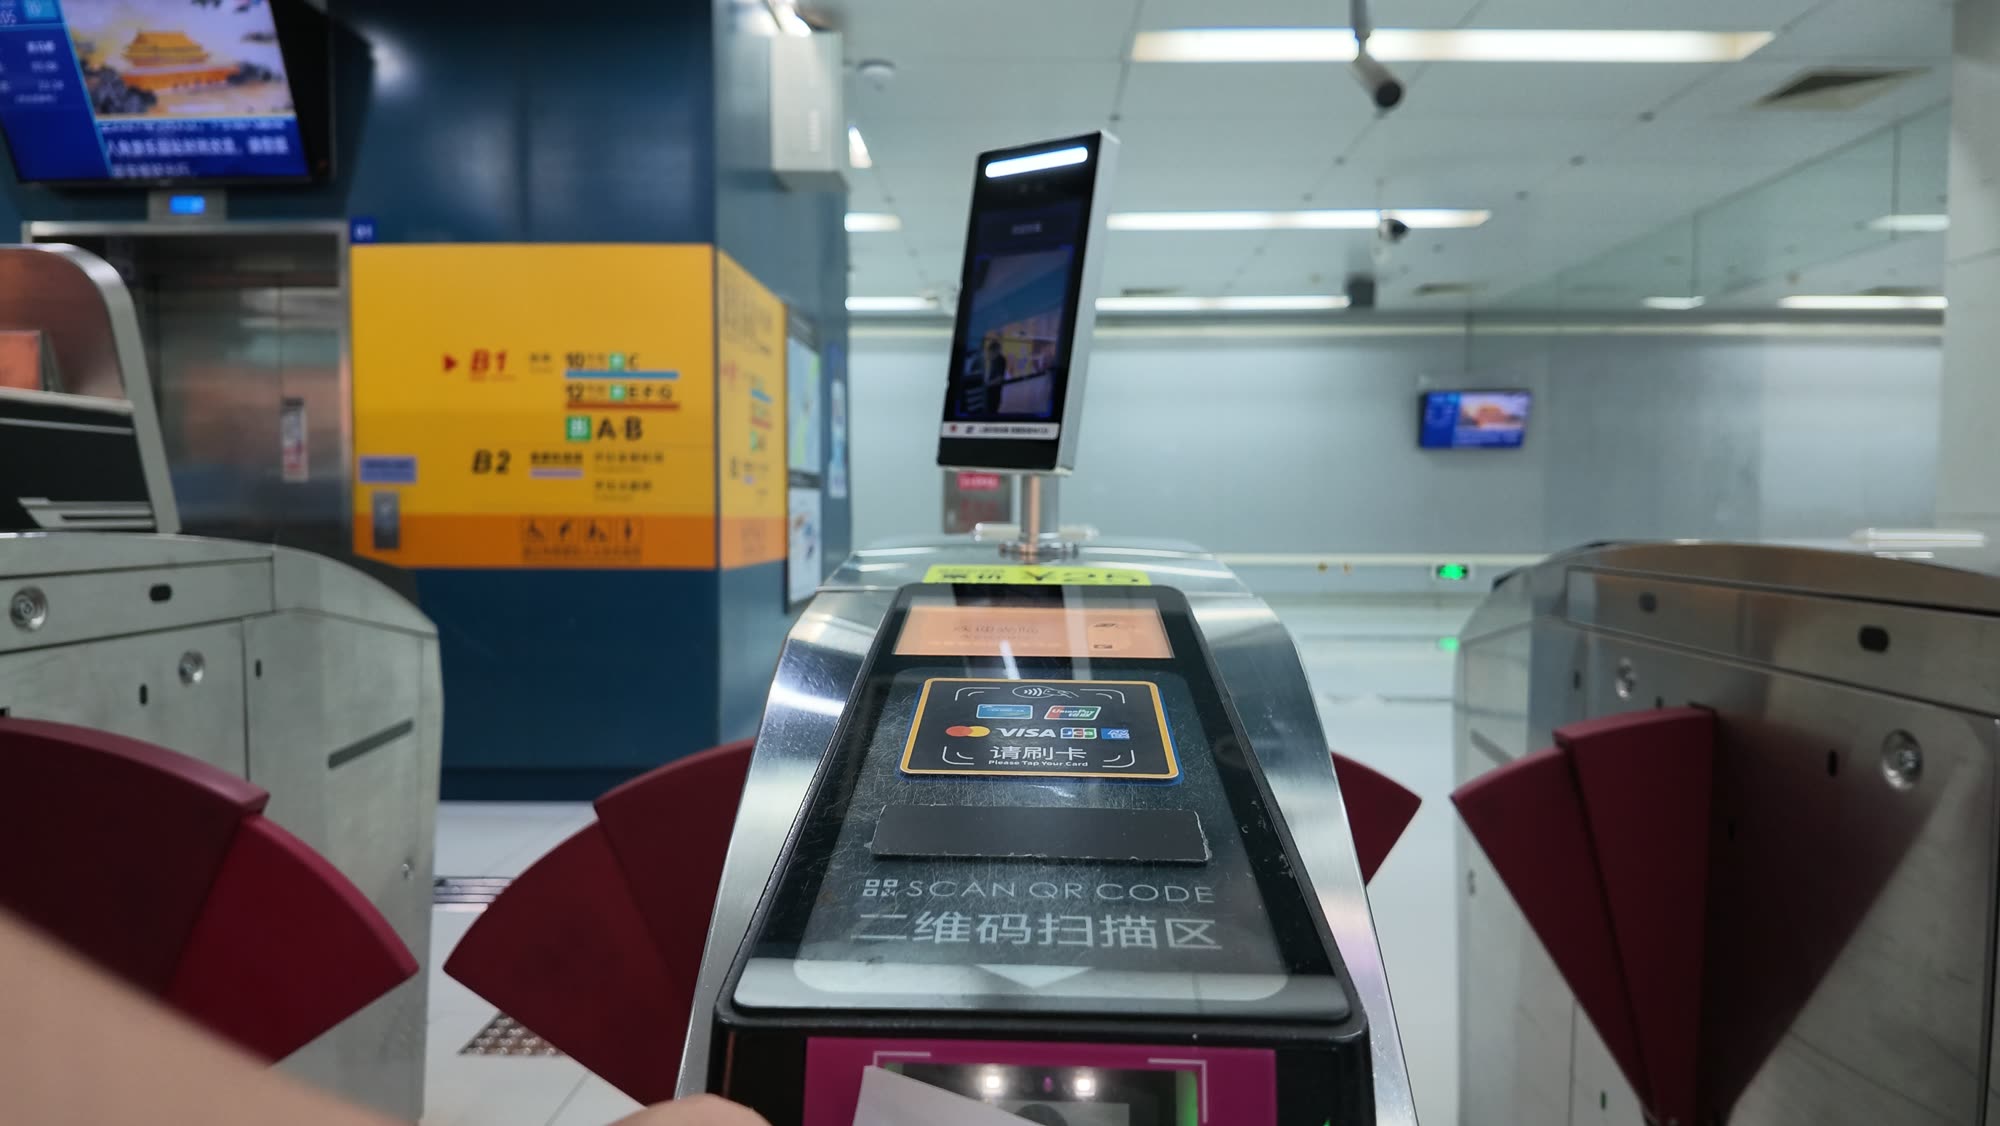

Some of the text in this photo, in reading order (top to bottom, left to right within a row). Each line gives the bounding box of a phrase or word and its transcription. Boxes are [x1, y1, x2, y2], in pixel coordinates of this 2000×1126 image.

[470, 348, 507, 372] B1
[471, 448, 512, 475] B2
[996, 727, 1057, 738] VISA
[1061, 729, 1096, 738] JCB
[989, 745, 1088, 761] 请刷卡
[906, 880, 1216, 903] SCAN QR CODE
[850, 911, 1223, 950] 二维码扫描区
